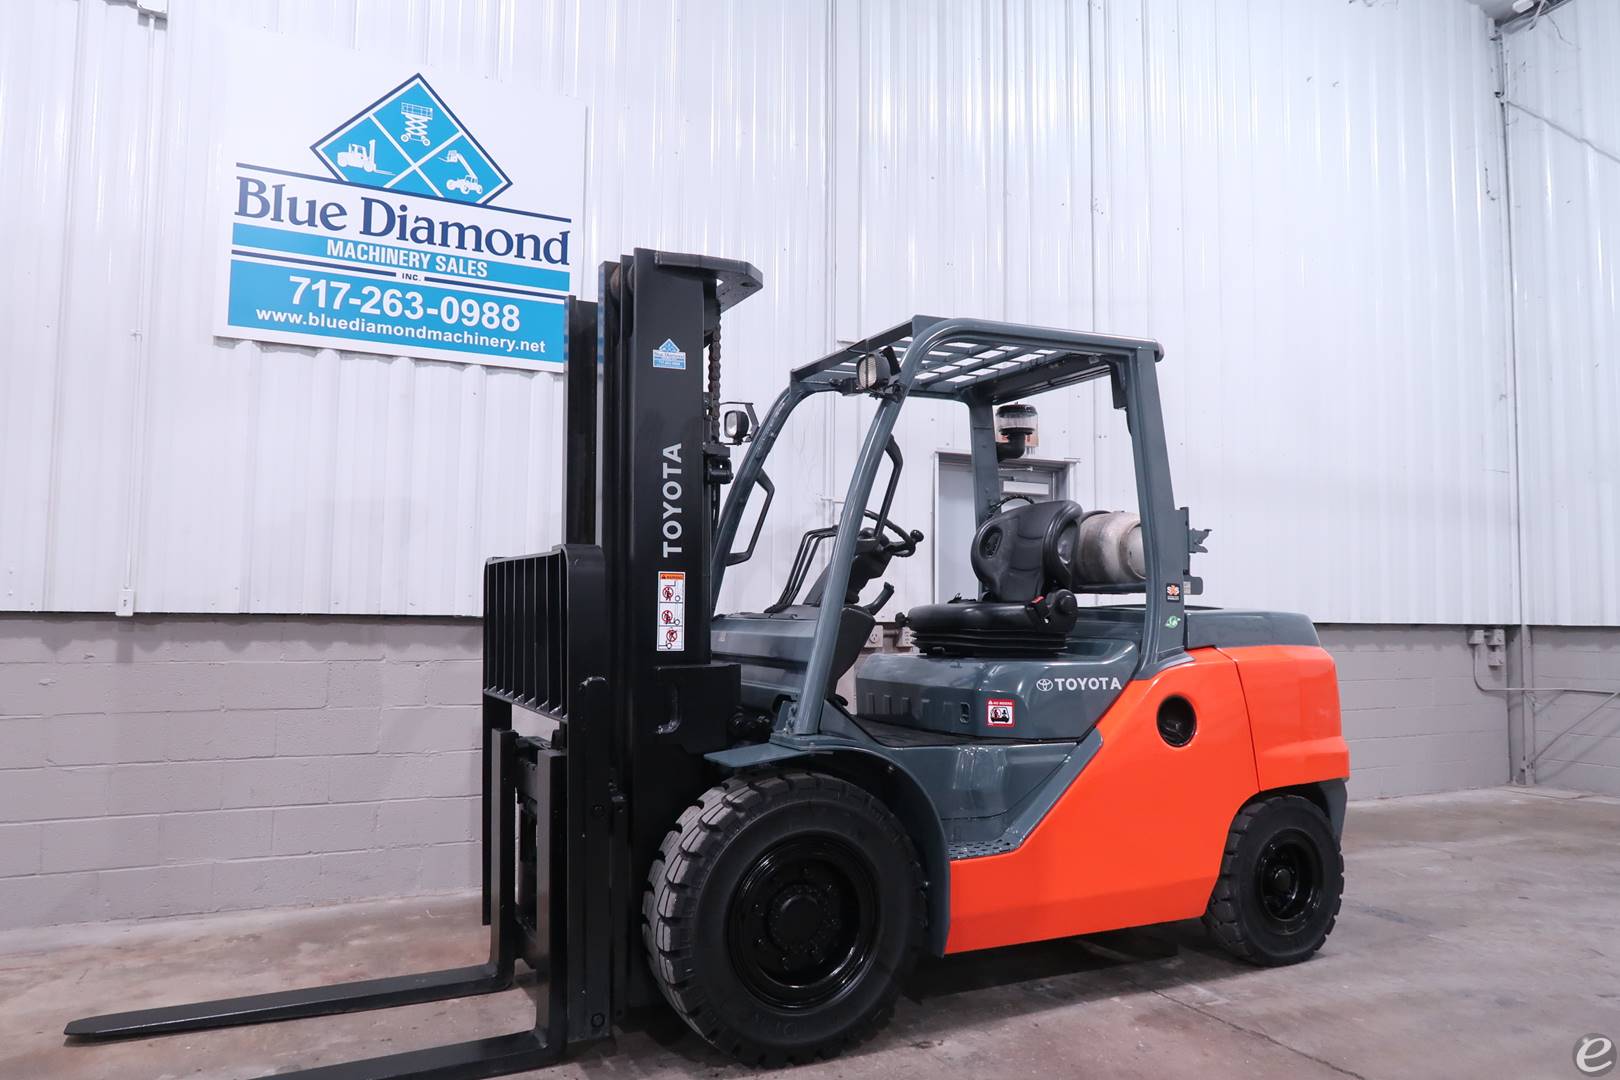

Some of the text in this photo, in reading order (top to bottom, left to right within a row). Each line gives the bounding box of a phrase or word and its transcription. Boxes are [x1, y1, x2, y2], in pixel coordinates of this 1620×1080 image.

[234, 176, 571, 266] Blue Diamond
[326, 239, 488, 277] MACHINERY SALES
[401, 272, 422, 282] INC.
[289, 275, 520, 332] 717-263-0988
[256, 308, 546, 353] www.bluediamondmachinery.net
[662, 443, 682, 558] TOYOTA
[1054, 677, 1122, 691] TOYOTA
